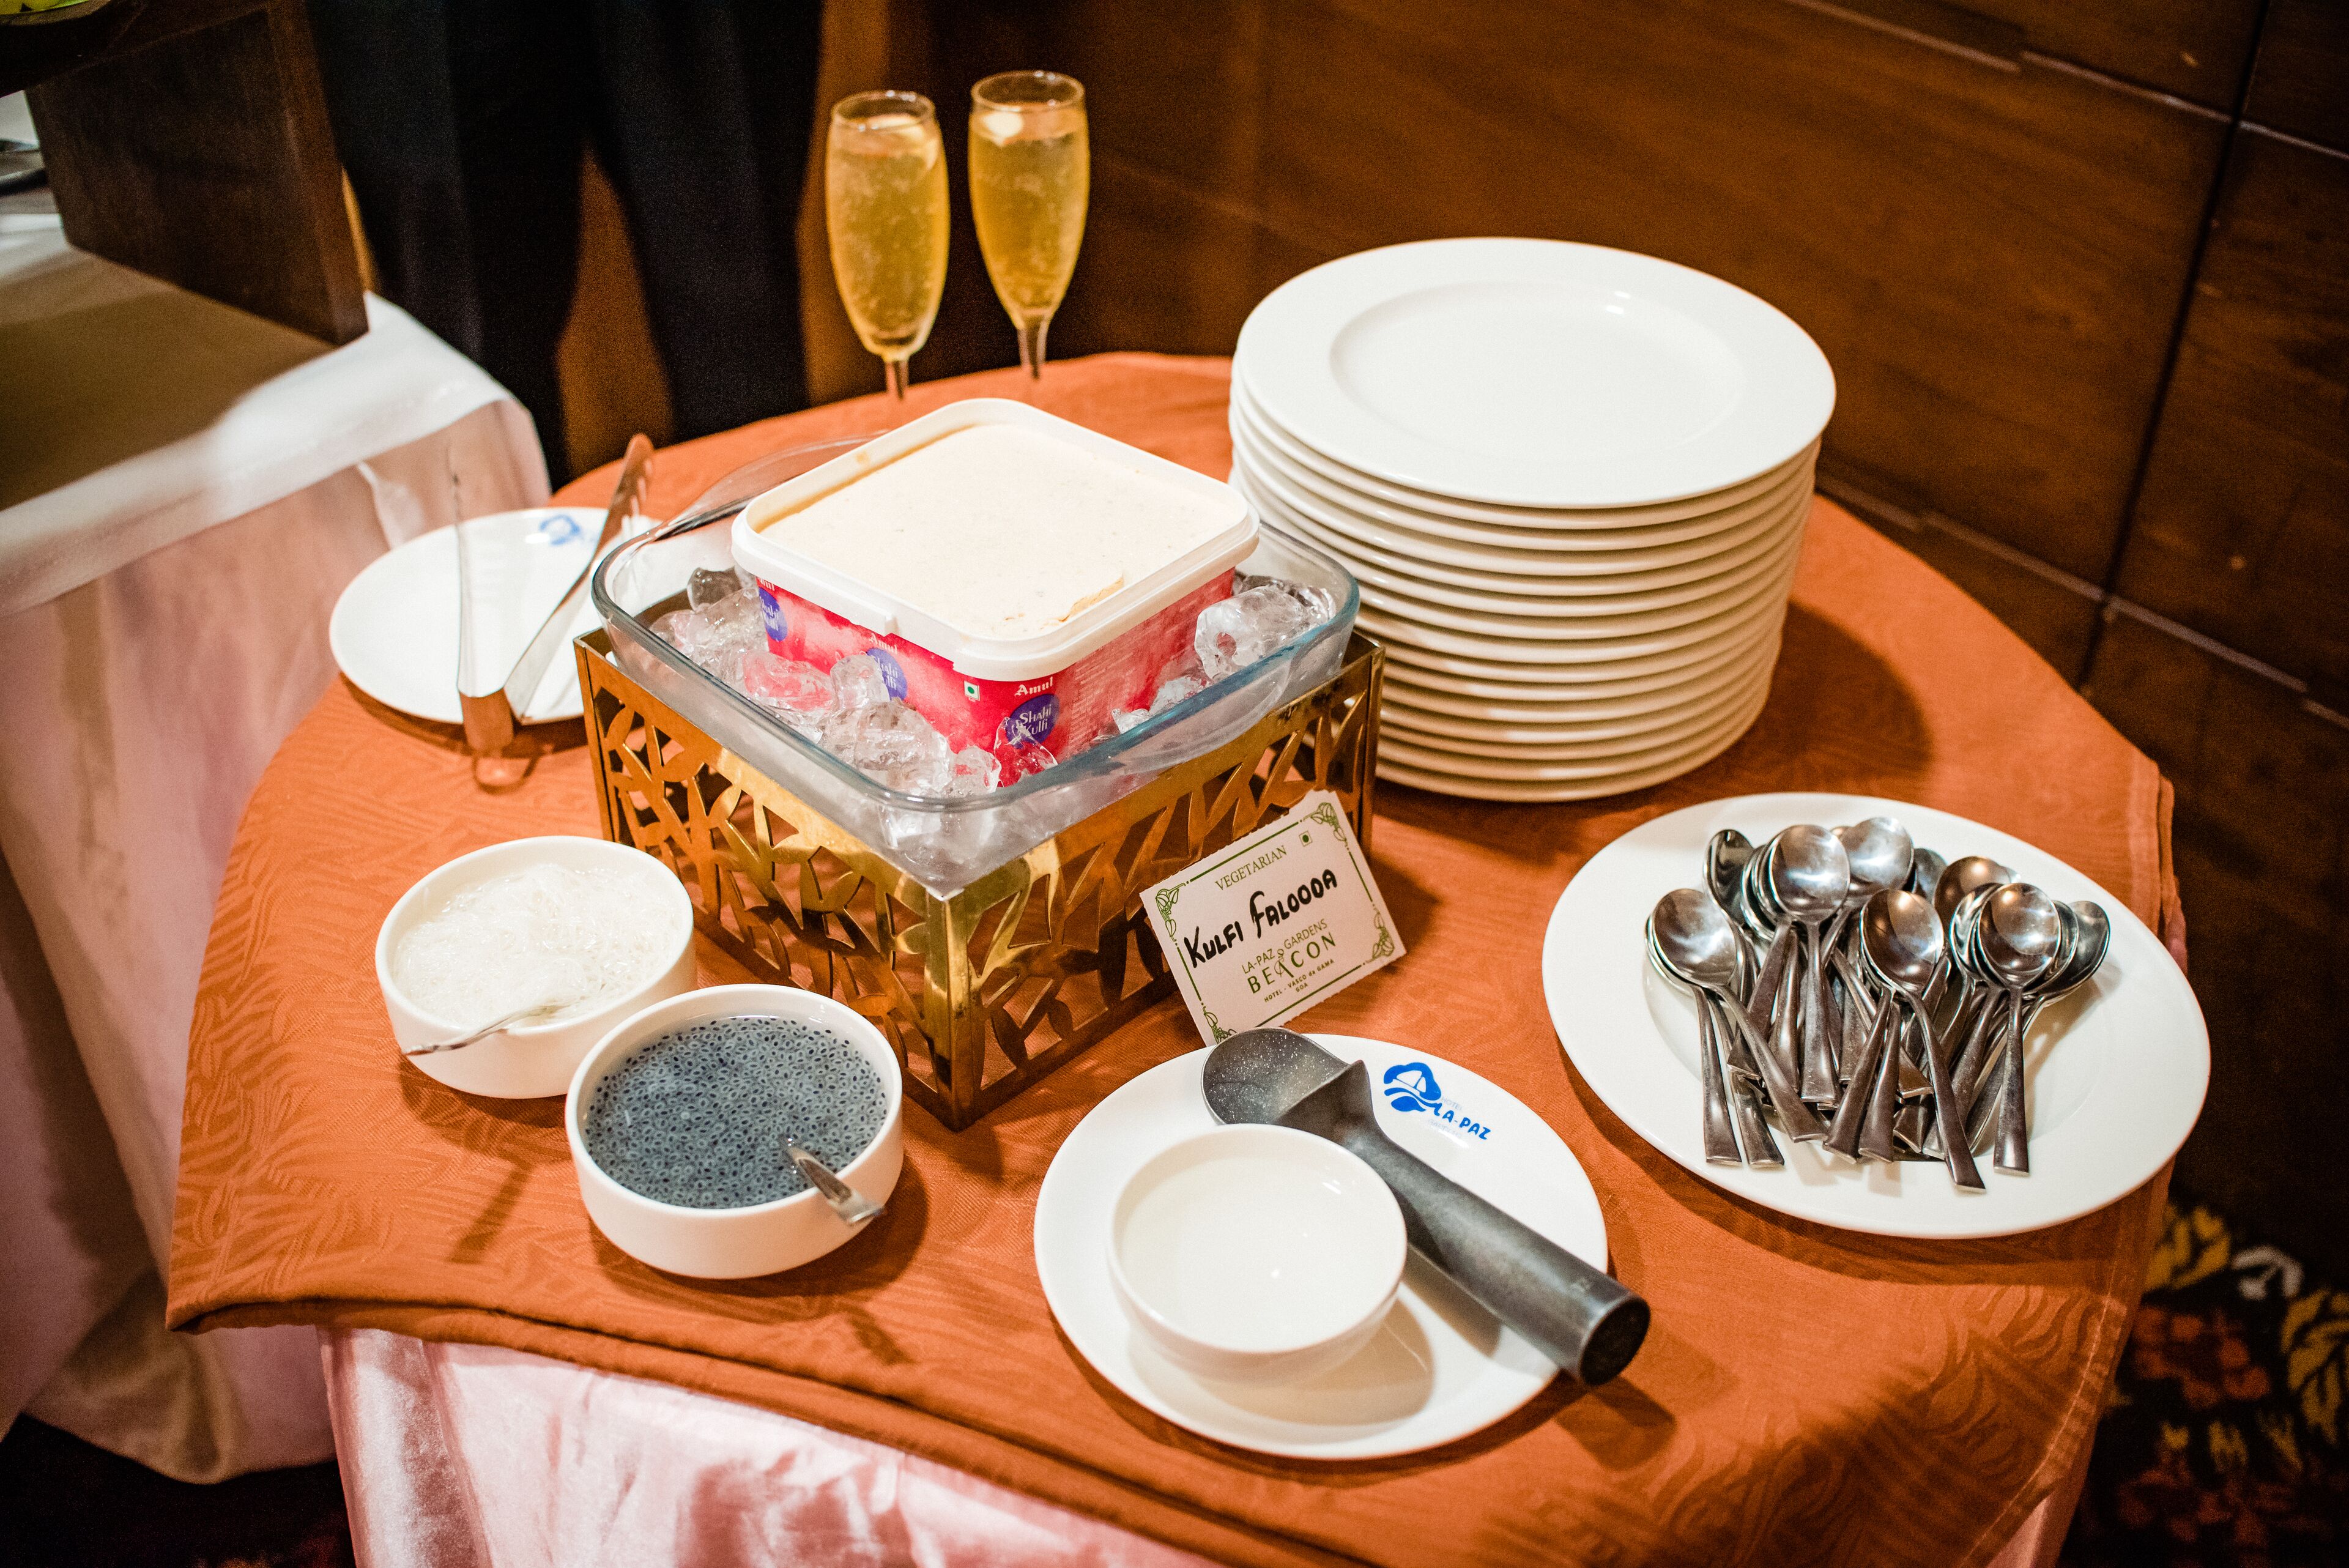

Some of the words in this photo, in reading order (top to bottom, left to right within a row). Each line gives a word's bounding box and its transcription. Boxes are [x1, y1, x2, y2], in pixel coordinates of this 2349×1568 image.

[869, 632, 898, 655] Amul
[1014, 676, 1053, 696] Amul
[1214, 845, 1288, 891] VEGETARIAN
[1183, 921, 1244, 968] KULFI
[1241, 948, 1276, 975] LA-PAZ
[1284, 918, 1329, 950] GARDENS
[1247, 931, 1336, 994] BEACON
[1264, 989, 1283, 1003] HOTEL
[1287, 974, 1307, 989] VASCO
[1316, 958, 1335, 972] GAMA
[1295, 983, 1308, 992] GOA
[1433, 1102, 1491, 1140] LA-PAZ
